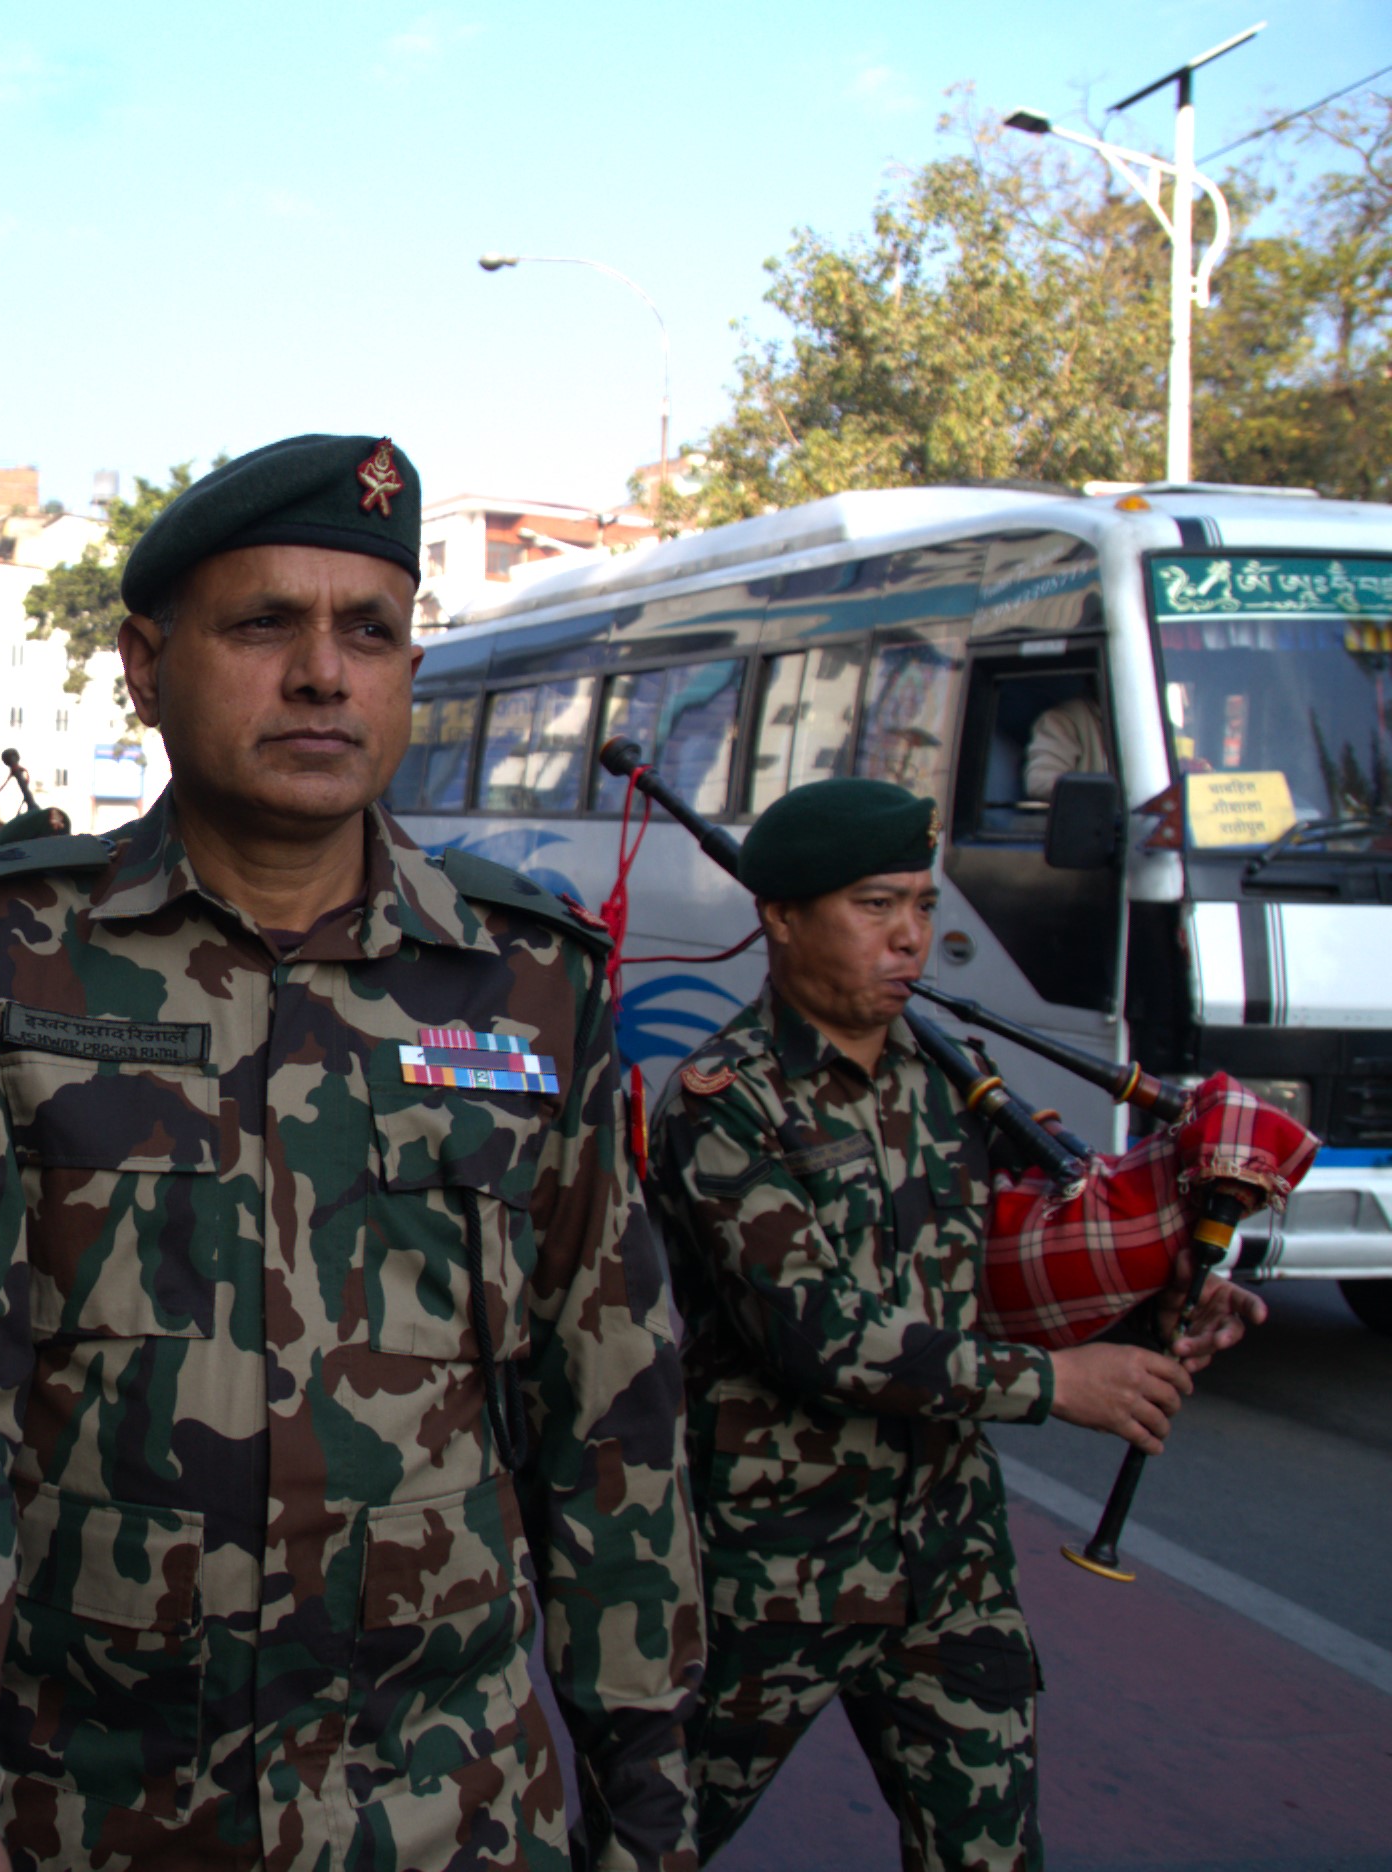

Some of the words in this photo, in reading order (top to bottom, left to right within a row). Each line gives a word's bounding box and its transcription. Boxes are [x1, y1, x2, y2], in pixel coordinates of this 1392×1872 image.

[83, 1042, 136, 1058] PRASAD
[141, 1047, 178, 1059] RIJAL
[477, 1071, 489, 1083] 2
